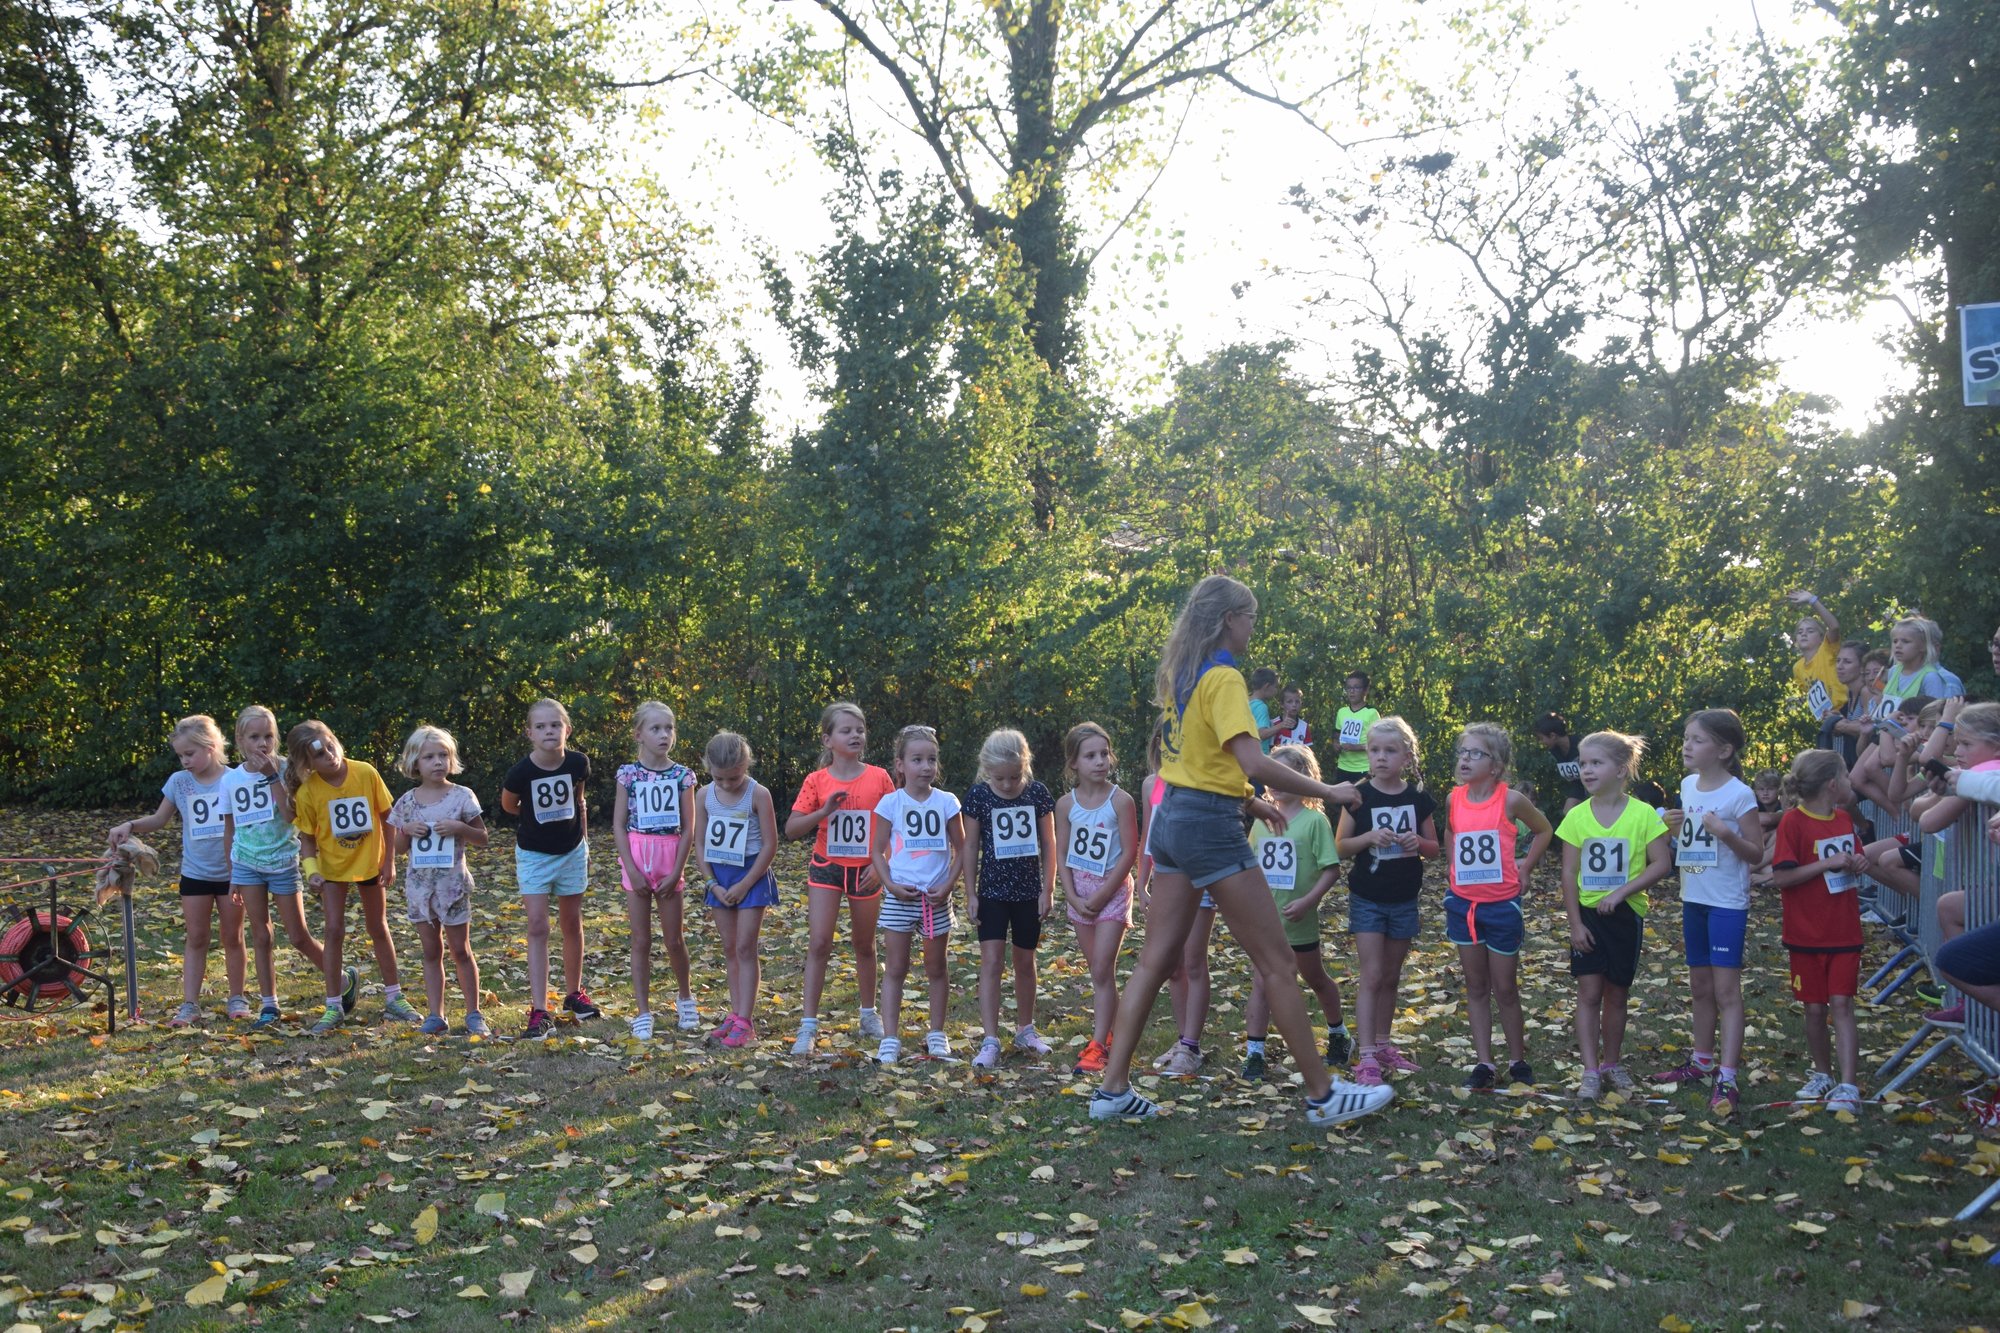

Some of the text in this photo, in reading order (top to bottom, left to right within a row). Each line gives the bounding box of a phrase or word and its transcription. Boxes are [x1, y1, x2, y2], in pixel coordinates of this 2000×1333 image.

[1969, 346, 2000, 381] S
[1808, 685, 1826, 709] 172
[1342, 721, 1361, 737] 209
[1560, 764, 1579, 778] 199
[235, 784, 269, 812] 95
[537, 780, 569, 808] 89
[639, 785, 675, 813] 102
[334, 801, 367, 829] 86
[830, 815, 866, 843] 103
[906, 809, 941, 837] 90
[996, 811, 1032, 840] 93
[1376, 811, 1412, 834] 84
[417, 827, 447, 852] 87
[710, 820, 745, 848] 97
[1074, 827, 1108, 860] 85
[1681, 817, 1714, 848] 94
[1262, 841, 1294, 870] 83
[1459, 834, 1496, 866] 88
[1588, 842, 1623, 873] 81
